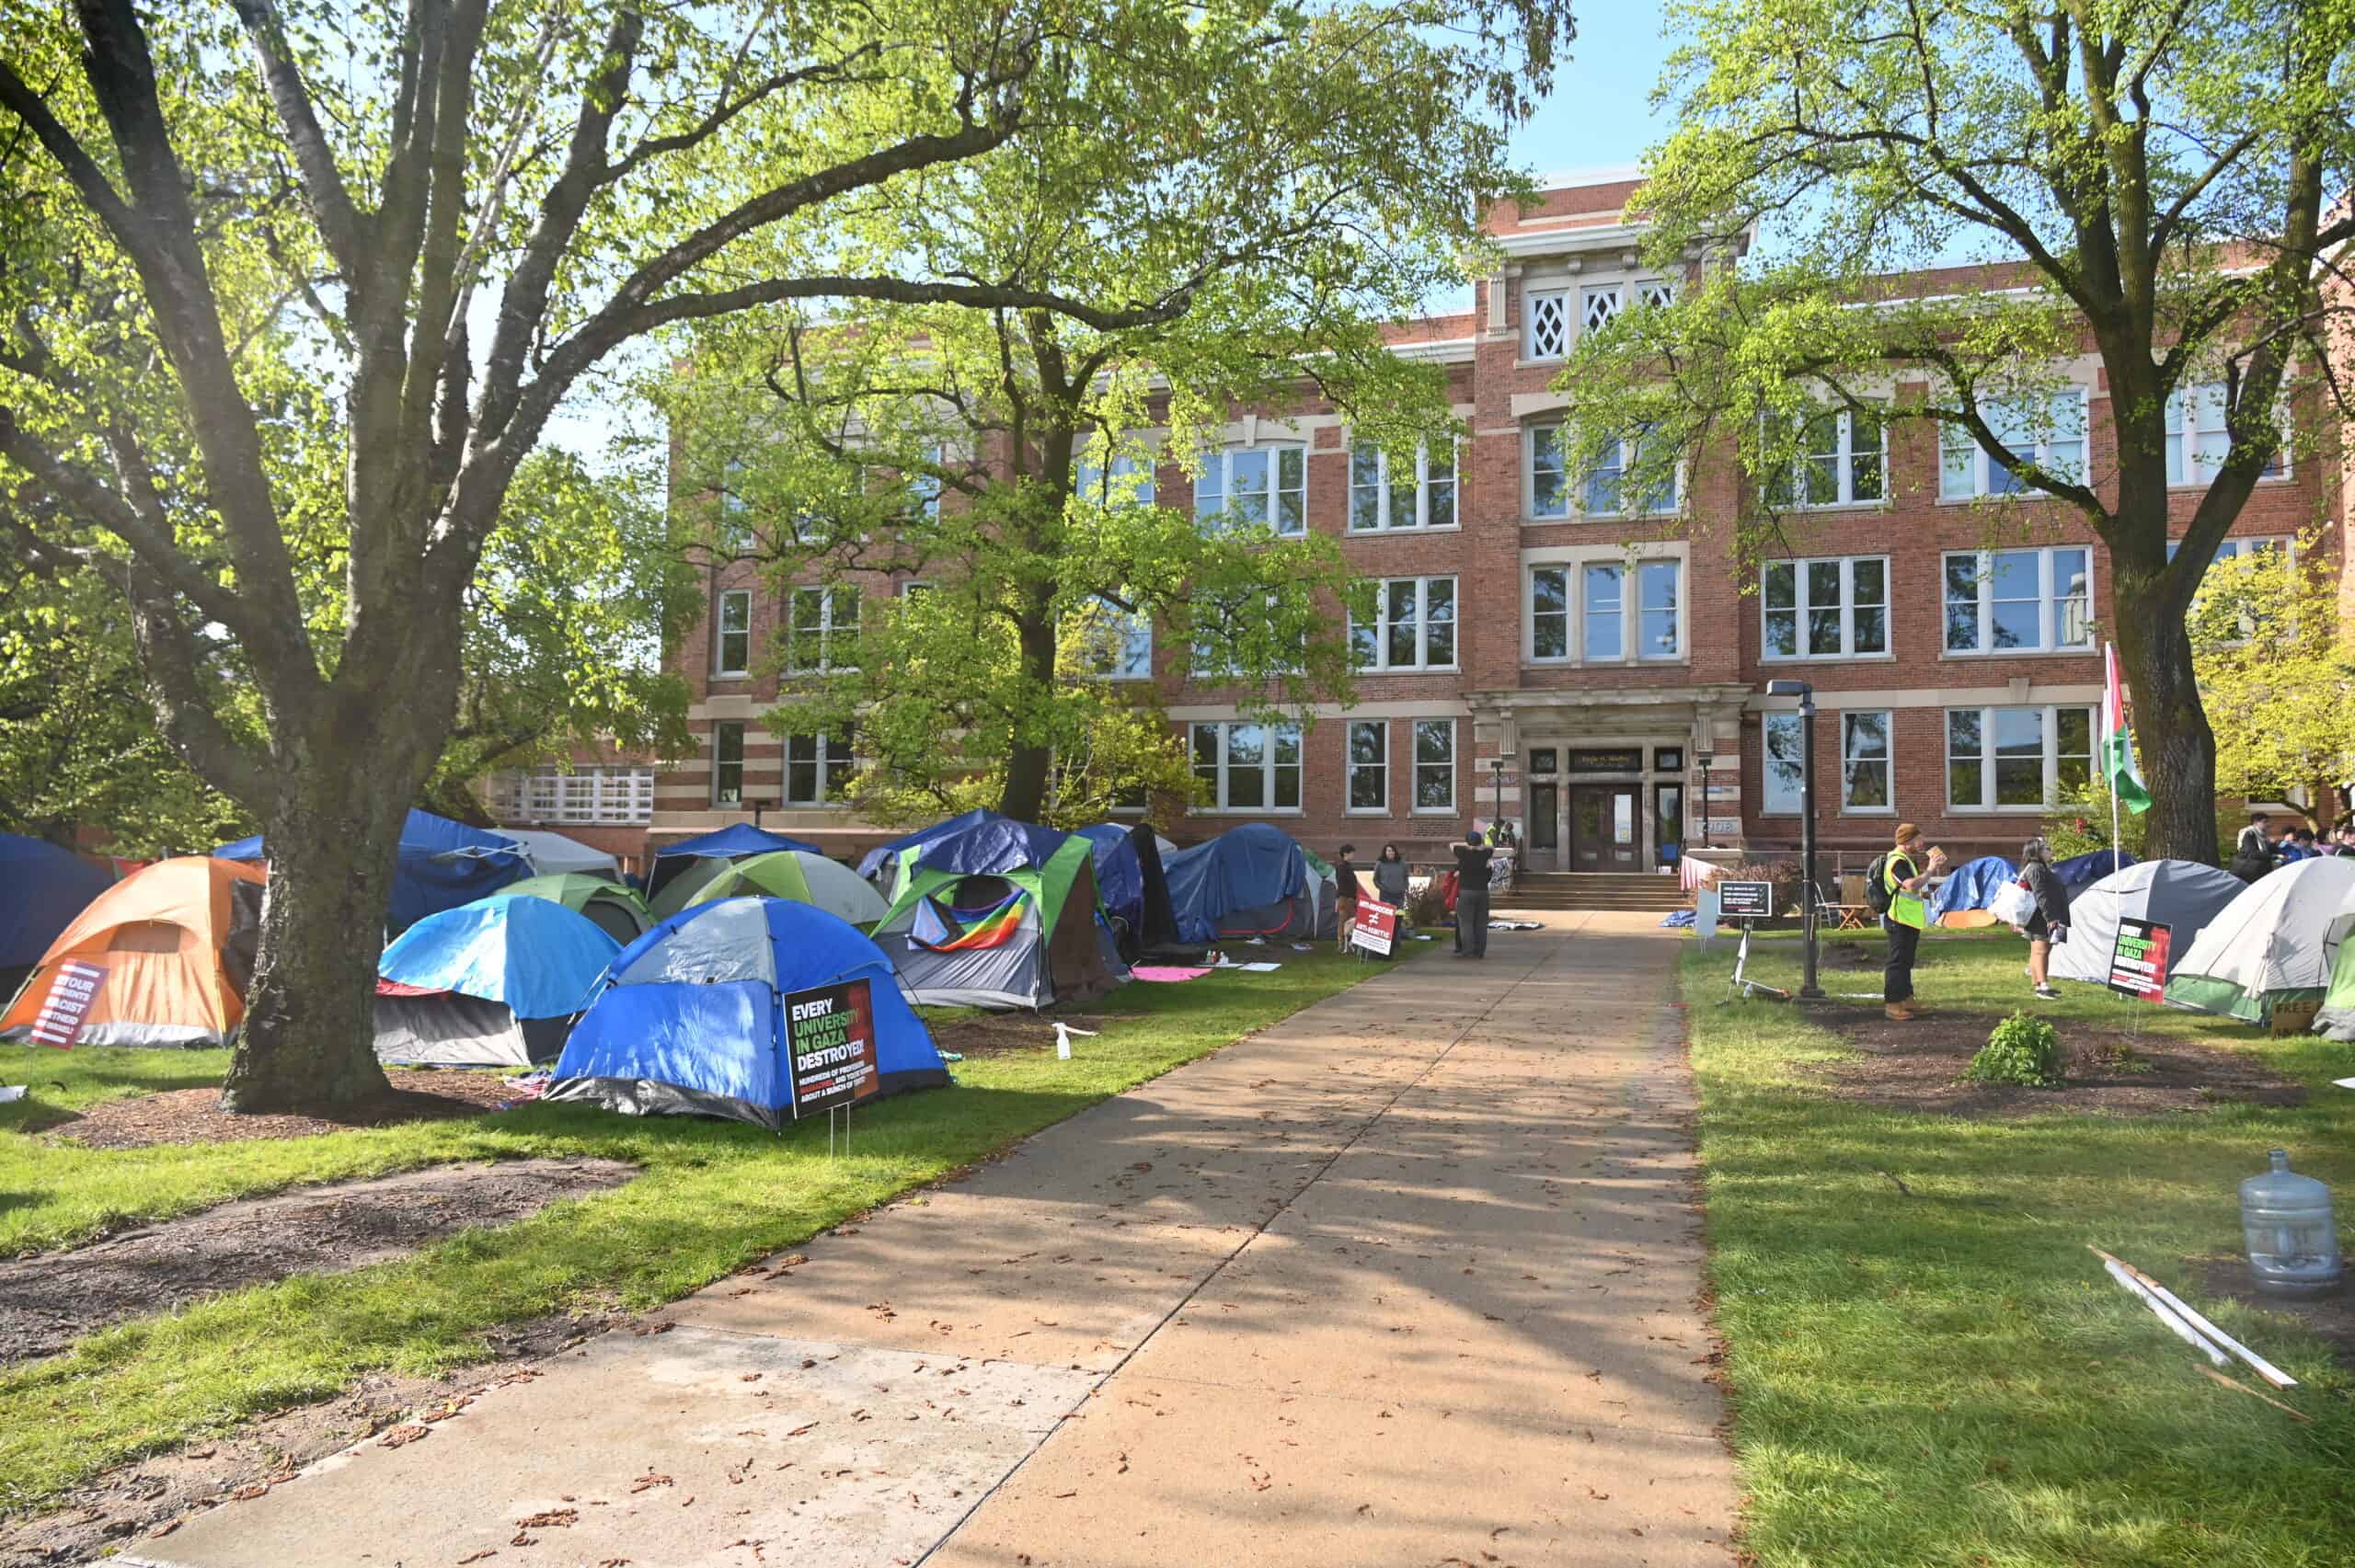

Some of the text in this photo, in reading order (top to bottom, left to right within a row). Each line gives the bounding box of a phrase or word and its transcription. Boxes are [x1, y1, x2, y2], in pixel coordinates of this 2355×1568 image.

[792, 998, 833, 1021] EVERY
[2276, 1001, 2312, 1014] FREE
[794, 1008, 859, 1037] UNIVERSITY
[796, 1029, 845, 1055] IN GAZA
[797, 1038, 865, 1071] DESTROYED!
